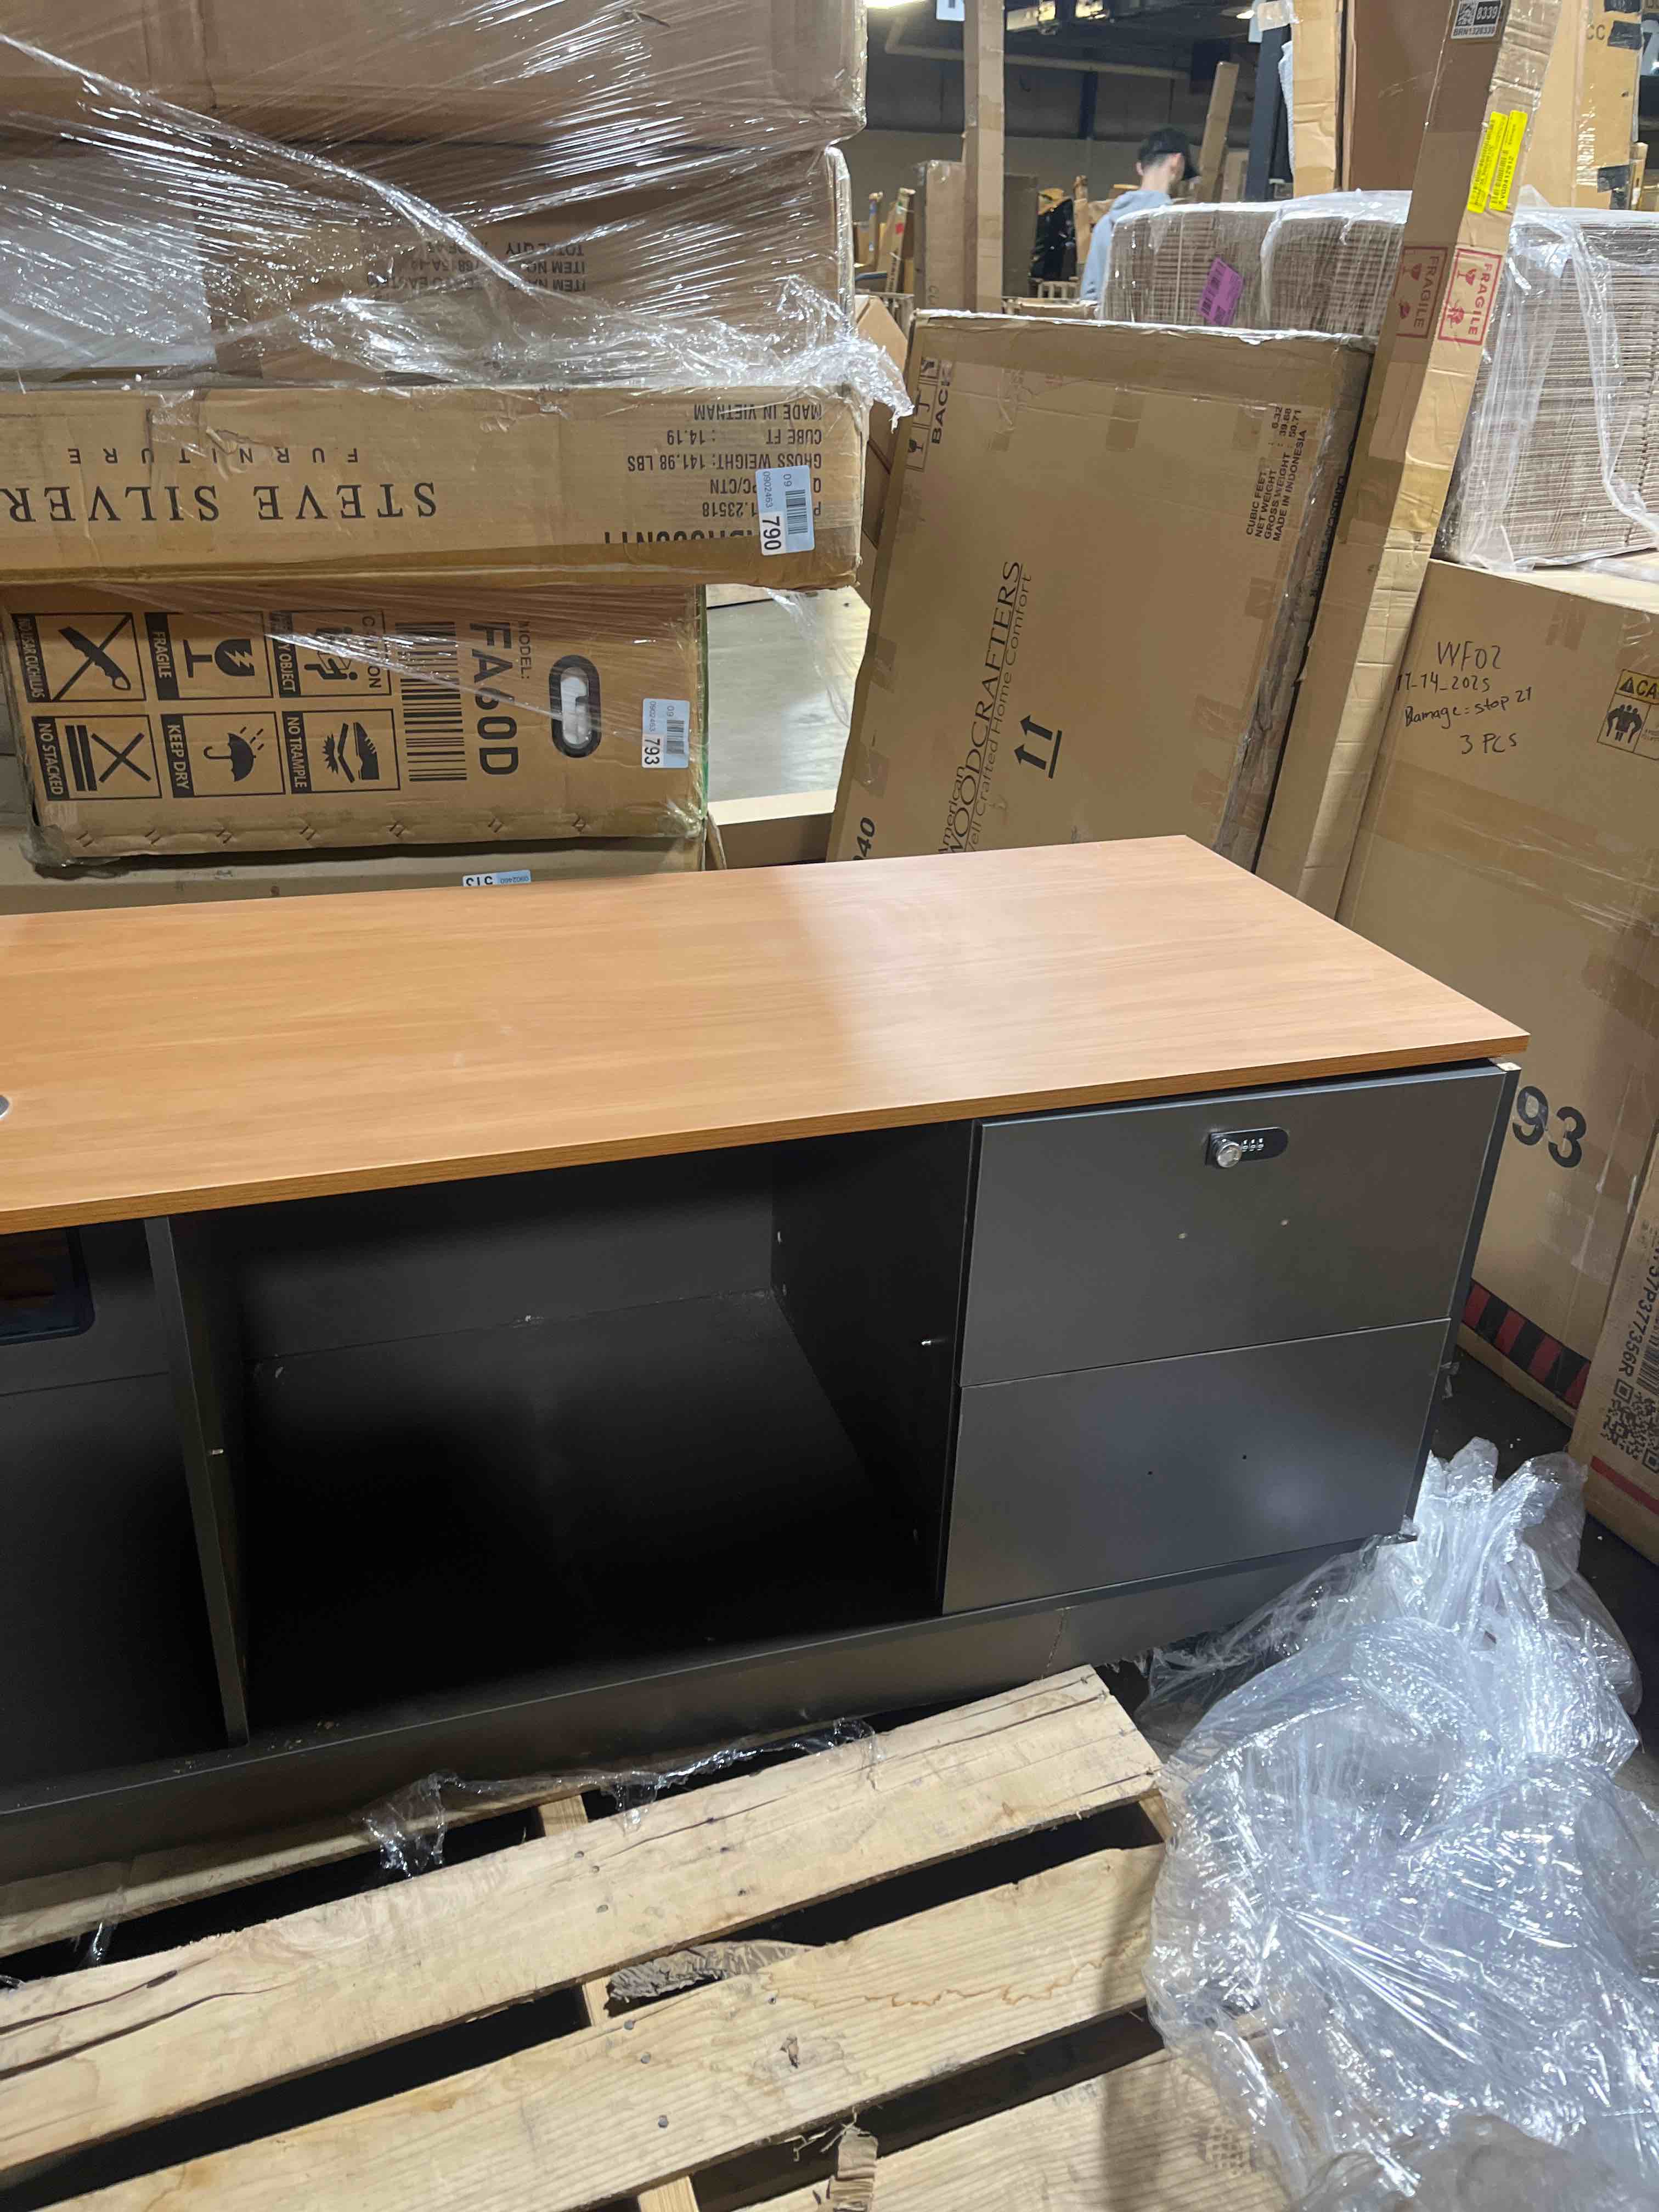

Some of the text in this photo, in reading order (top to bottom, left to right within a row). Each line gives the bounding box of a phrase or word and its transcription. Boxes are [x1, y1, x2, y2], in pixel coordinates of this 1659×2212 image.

[1476, 7, 1498, 20] 8339
[551, 261, 585, 273] ITEM
[552, 279, 586, 292] ITEM
[1414, 254, 1442, 328] FRAGILE
[1468, 263, 1494, 336] FRAGILE
[694, 403, 822, 421] MADE IN VIETNAM
[69, 446, 358, 466] FURNITURE
[667, 430, 706, 445] 14.19
[766, 430, 781, 445] FT
[788, 430, 822, 445] CUBE
[627, 453, 822, 471] GROSS WEIGHT: 141.98 LBS
[0, 482, 437, 523] STEVE SILVER
[763, 471, 773, 508] 0902463
[1246, 501, 1260, 535] CUBIC
[1254, 471, 1267, 498] FEET
[1260, 469, 1277, 513] WEIGHT
[1265, 500, 1279, 539] GROSS
[1274, 452, 1290, 497] WEIGHT
[1273, 430, 1307, 541] MADE IN INDONESIA
[762, 516, 781, 551] 790
[1255, 517, 1267, 538] NET
[21, 632, 39, 655] USAR
[152, 630, 173, 679] FRAGILE
[518, 621, 533, 679] MODEL:
[1437, 640, 1502, 671] WF02
[24, 655, 46, 698] CUCHILLAS
[278, 653, 296, 692] OBJECT
[968, 573, 1032, 851] ell Crafted Home Comfort
[1474, 696, 1509, 715] stop
[1514, 686, 1532, 703] 21
[38, 723, 64, 795] NO STACKED
[166, 724, 190, 789] KEEP DRY
[287, 716, 307, 788] NO TRAMPLE
[644, 738, 661, 765] 793
[1460, 734, 1474, 754] 3
[852, 817, 876, 861] 40
[1511, 1085, 1588, 1169] 93
